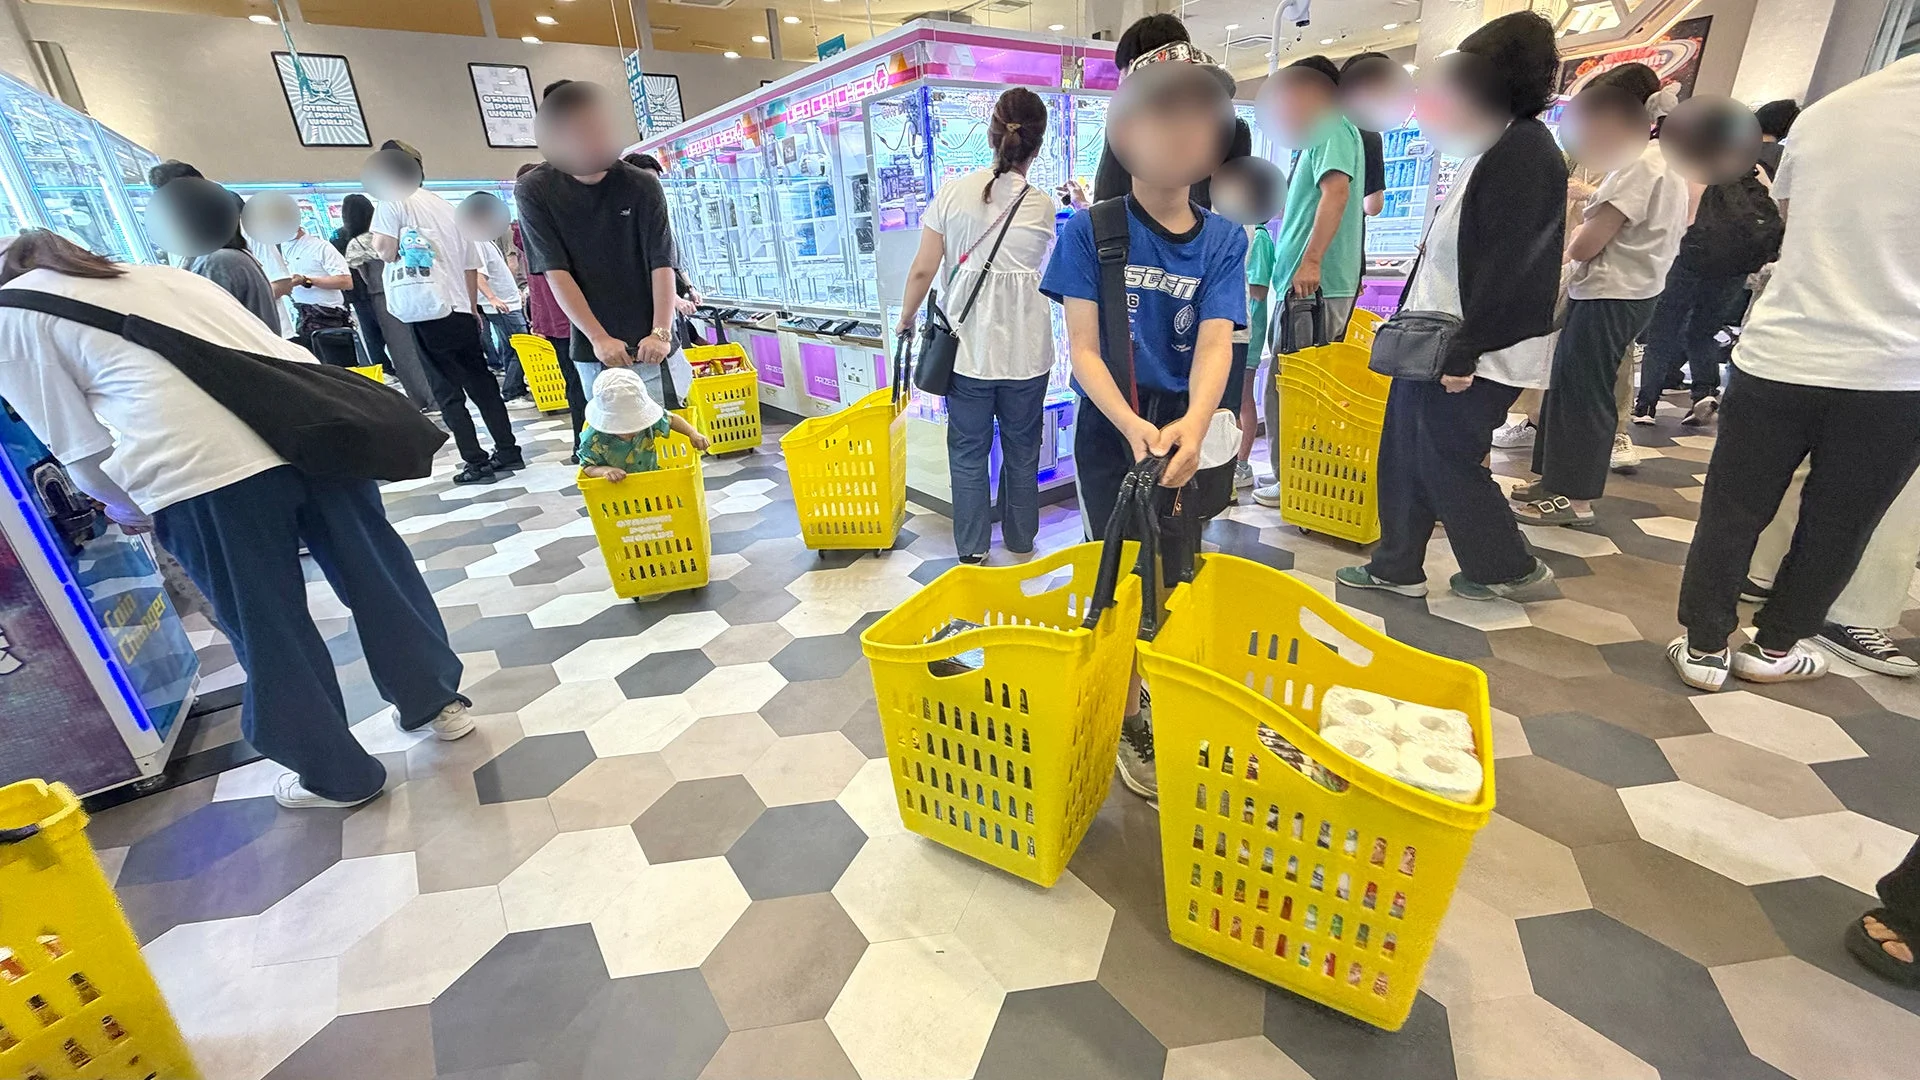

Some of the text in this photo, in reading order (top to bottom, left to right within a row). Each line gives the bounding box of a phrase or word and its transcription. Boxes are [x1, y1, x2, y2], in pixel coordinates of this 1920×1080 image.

[1124, 265, 1202, 300] SCEN
[1126, 293, 1139, 308] 6
[104, 595, 136, 637] Coin
[119, 592, 166, 665] Changer
